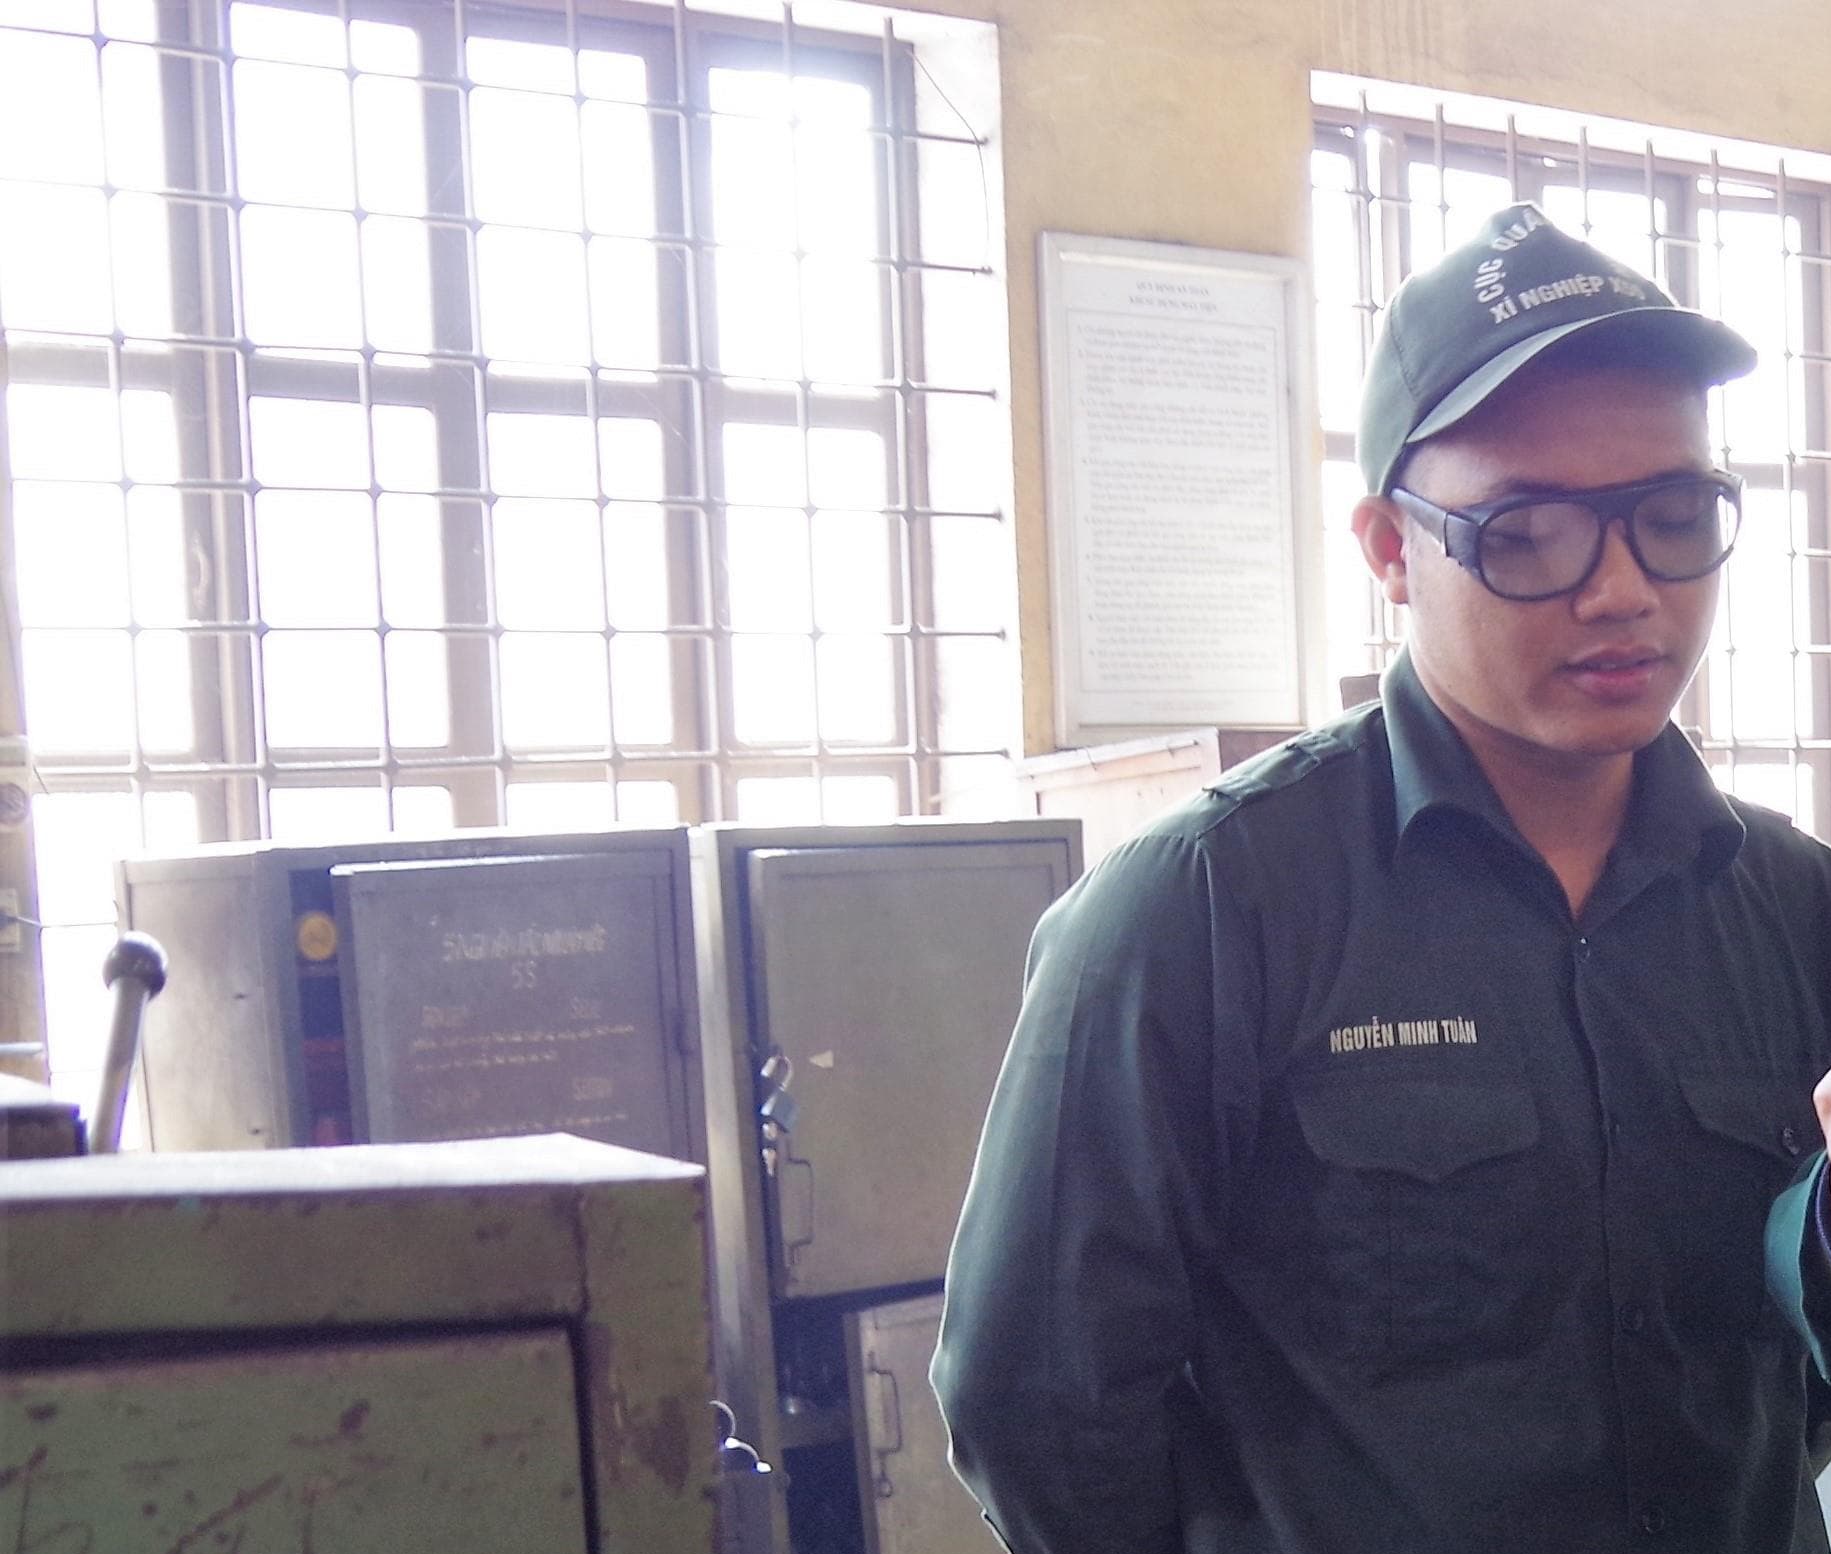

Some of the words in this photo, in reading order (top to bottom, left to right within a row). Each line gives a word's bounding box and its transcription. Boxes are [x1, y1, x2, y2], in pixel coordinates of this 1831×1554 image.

[1489, 296, 1518, 324] XÍ
[1519, 274, 1604, 310] NGHIỆP
[1330, 1016, 1394, 1053] NGUYỄN
[1398, 1020, 1439, 1046] MINH
